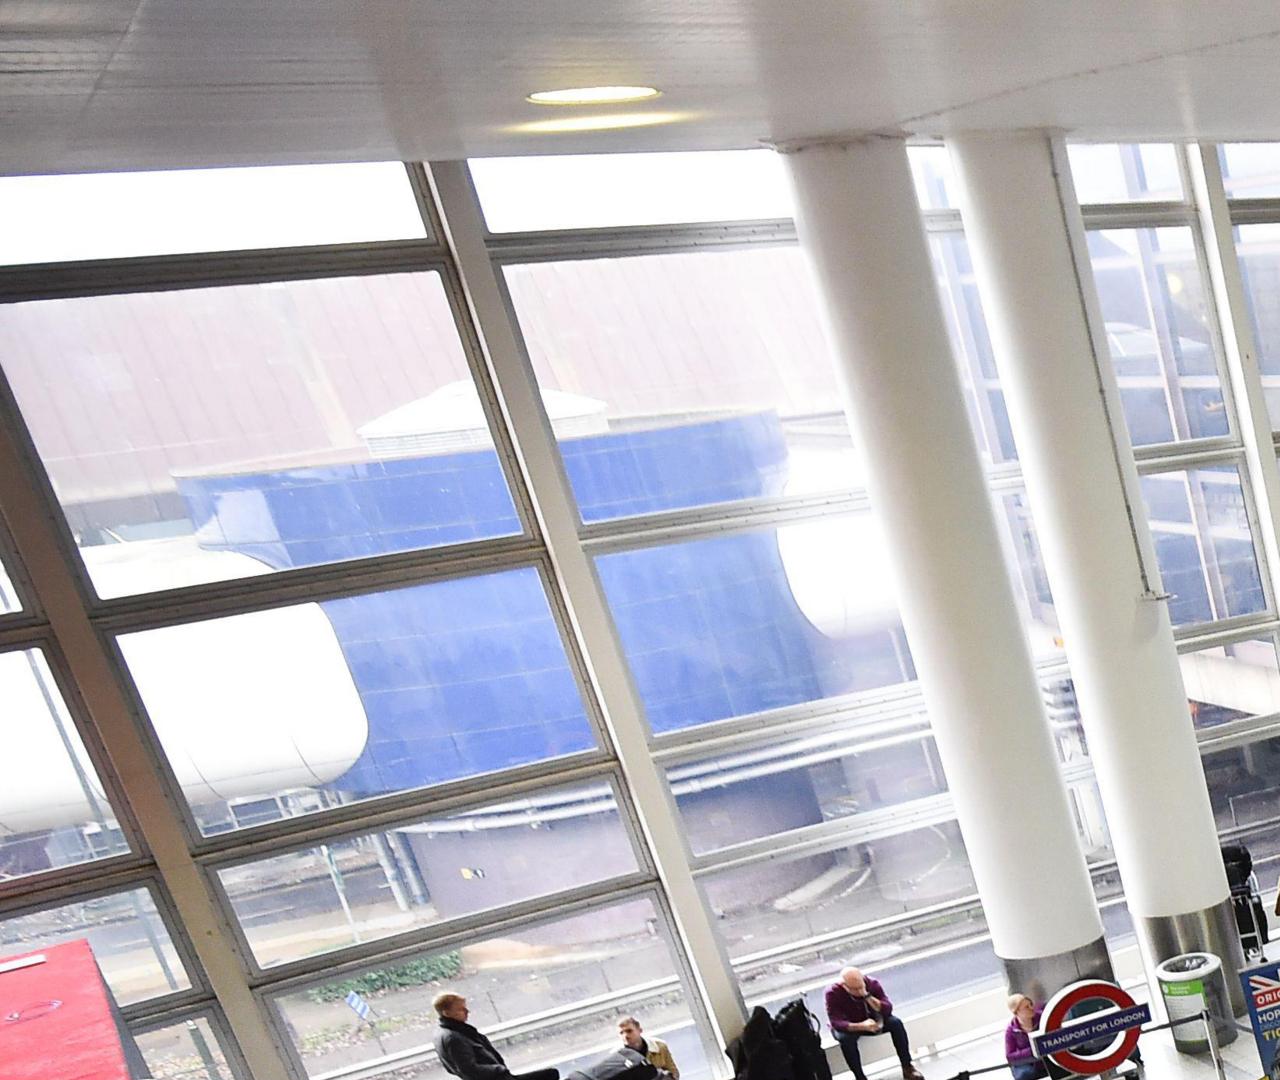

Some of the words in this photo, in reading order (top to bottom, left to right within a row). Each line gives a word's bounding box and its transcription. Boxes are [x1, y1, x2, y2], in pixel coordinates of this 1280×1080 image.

[1041, 1028, 1090, 1049] TRANSPORT
[1091, 1022, 1110, 1034] FOR
[1109, 1010, 1147, 1029] LONDON
